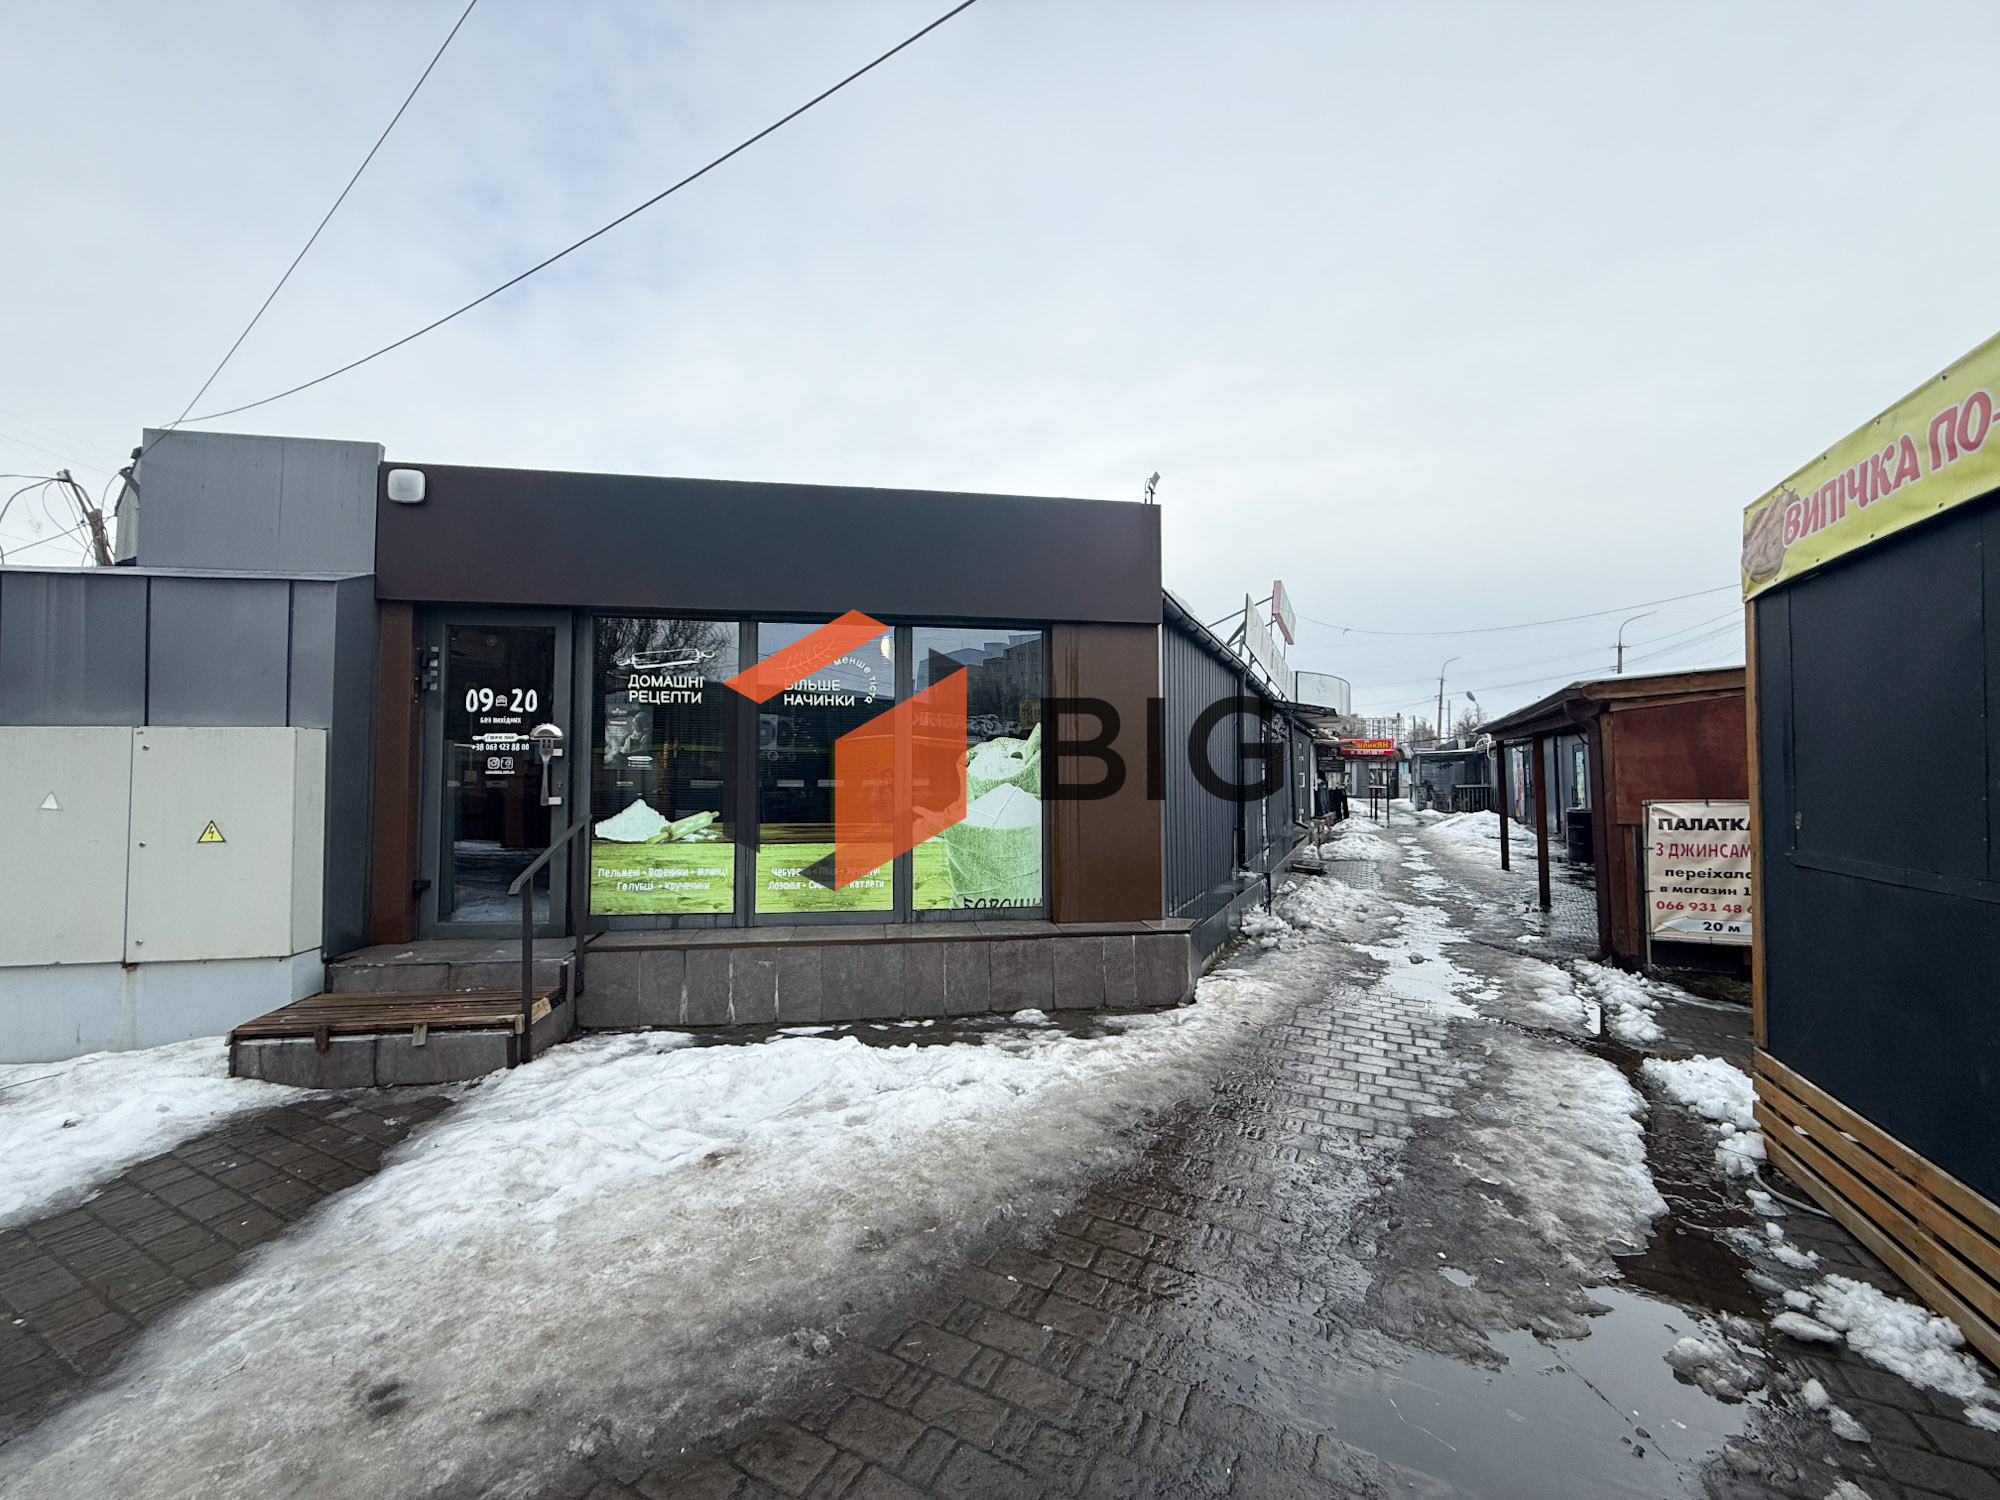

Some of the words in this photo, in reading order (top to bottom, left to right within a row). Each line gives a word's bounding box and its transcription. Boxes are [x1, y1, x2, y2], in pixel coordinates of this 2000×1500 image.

[1783, 435, 1921, 546] ВИПІЧКА
[628, 674, 705, 689] ДОМАШНІ
[784, 679, 841, 691] БІЛЬШЕ
[834, 656, 872, 674] менше
[863, 675, 879, 704] тіста
[465, 688, 494, 712] 09
[509, 688, 538, 713] 20
[629, 690, 702, 705] РЕЦЕПТИ
[783, 694, 855, 706] НАЧИНКИ
[1354, 741, 1389, 749] шликЯН
[771, 867, 811, 878] Чебуре
[1672, 886, 1737, 896] магазин
[1656, 901, 1684, 910] 066
[1688, 902, 1717, 912] 931
[1722, 904, 1742, 913] 48
[1702, 922, 1723, 931] 20
